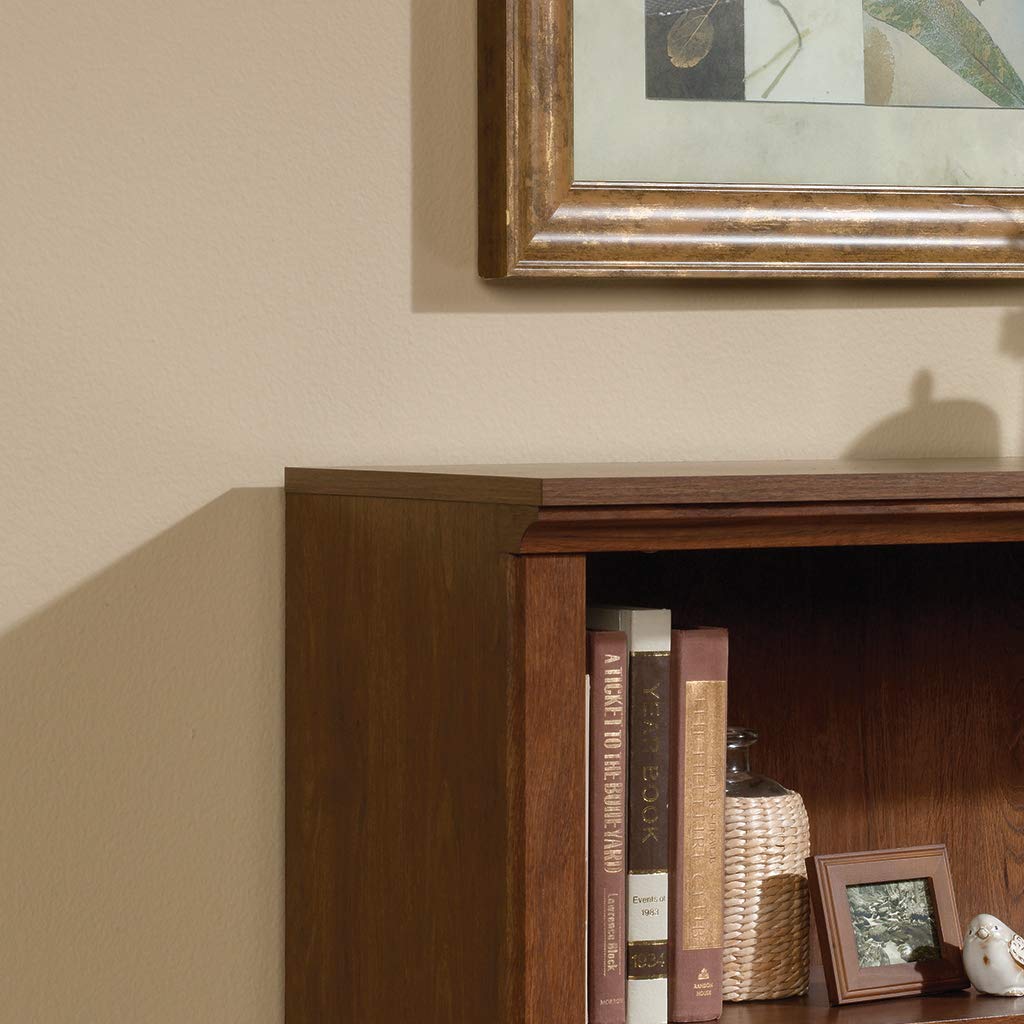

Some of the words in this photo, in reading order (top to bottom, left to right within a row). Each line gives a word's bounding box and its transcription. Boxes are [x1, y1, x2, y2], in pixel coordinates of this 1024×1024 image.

[604, 654, 621, 664] A
[604, 667, 623, 728] TICKET
[603, 730, 622, 749] TO
[603, 752, 622, 780] THE
[642, 766, 660, 843] BOOK
[604, 782, 623, 873] BONEYARD
[632, 895, 658, 904] Events
[607, 893, 618, 940] Lawrence
[607, 942, 618, 972] Block
[693, 982, 714, 990] RANDOM
